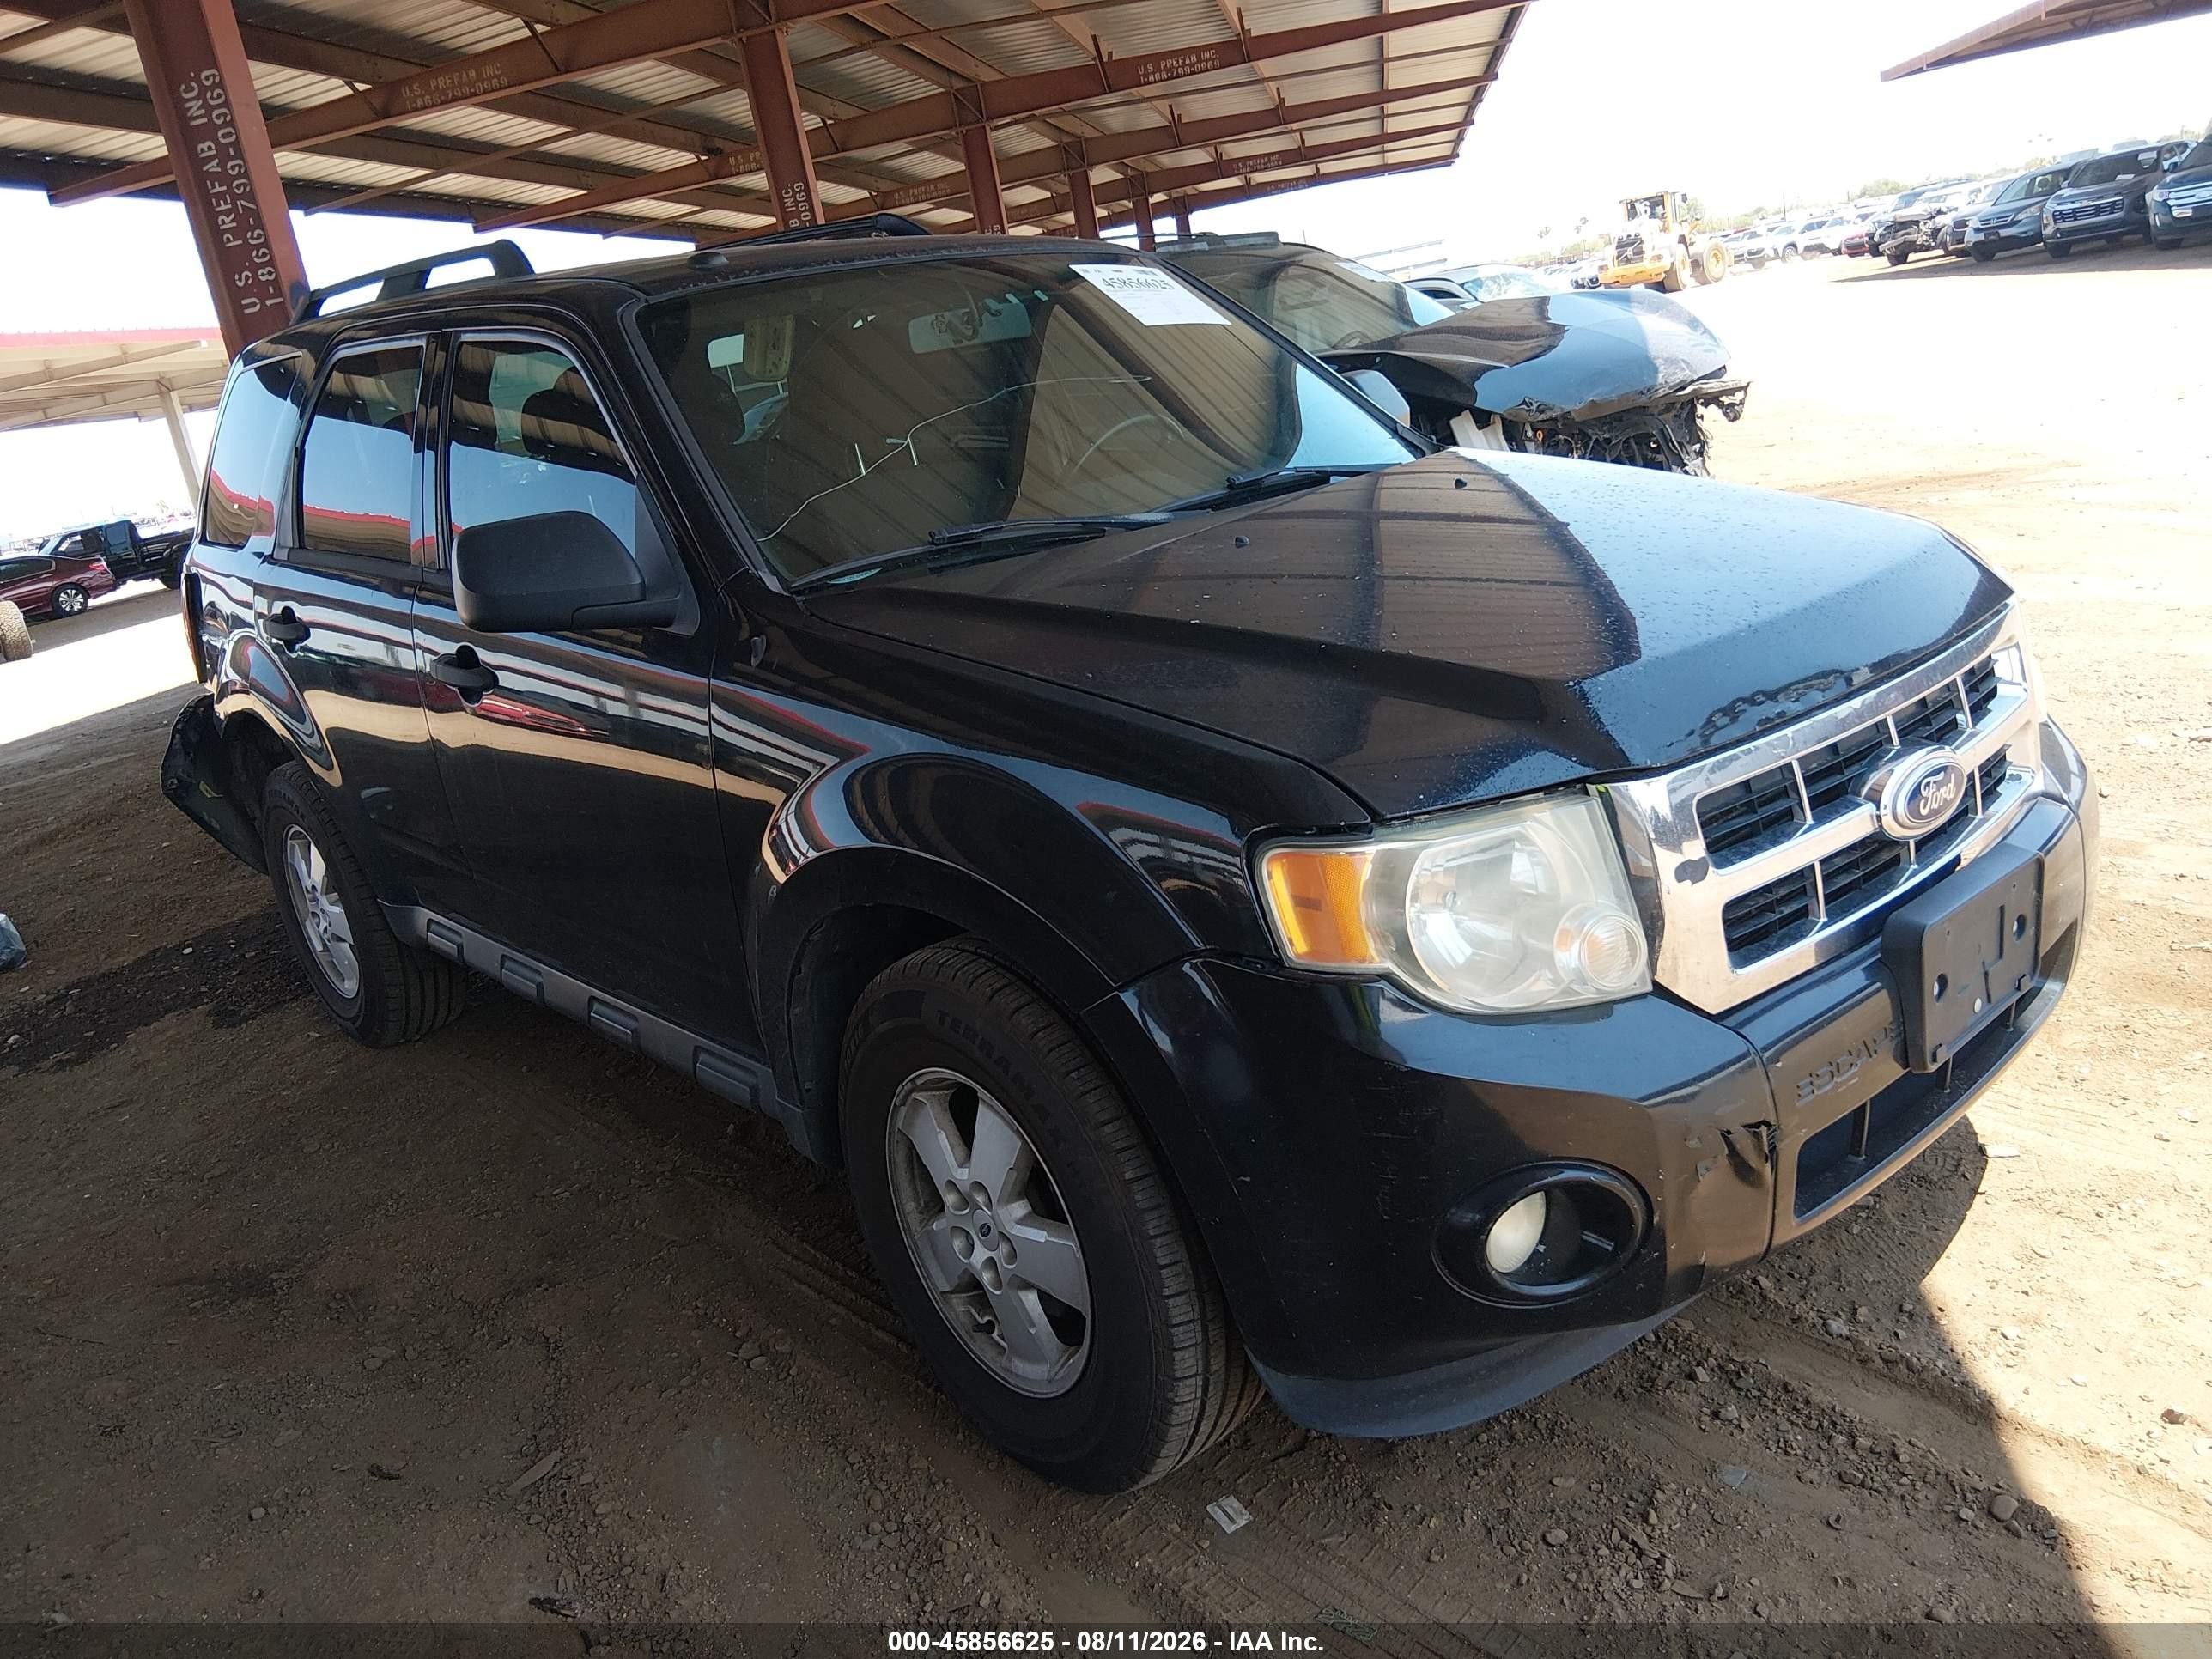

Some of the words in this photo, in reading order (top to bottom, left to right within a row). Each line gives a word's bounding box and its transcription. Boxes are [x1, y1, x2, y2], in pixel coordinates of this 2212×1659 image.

[429, 68, 477, 90] PREFAB
[1160, 53, 1197, 70] PREFAB
[1200, 49, 1219, 60] INC.
[179, 71, 208, 126] INC.
[198, 140, 243, 247] PREFAB
[200, 68, 284, 307] 1-866-799-0969
[782, 183, 797, 211] INC.
[234, 261, 261, 314] U.S.
[1102, 276, 1176, 290] 45856625
[1920, 771, 1956, 816] Ford
